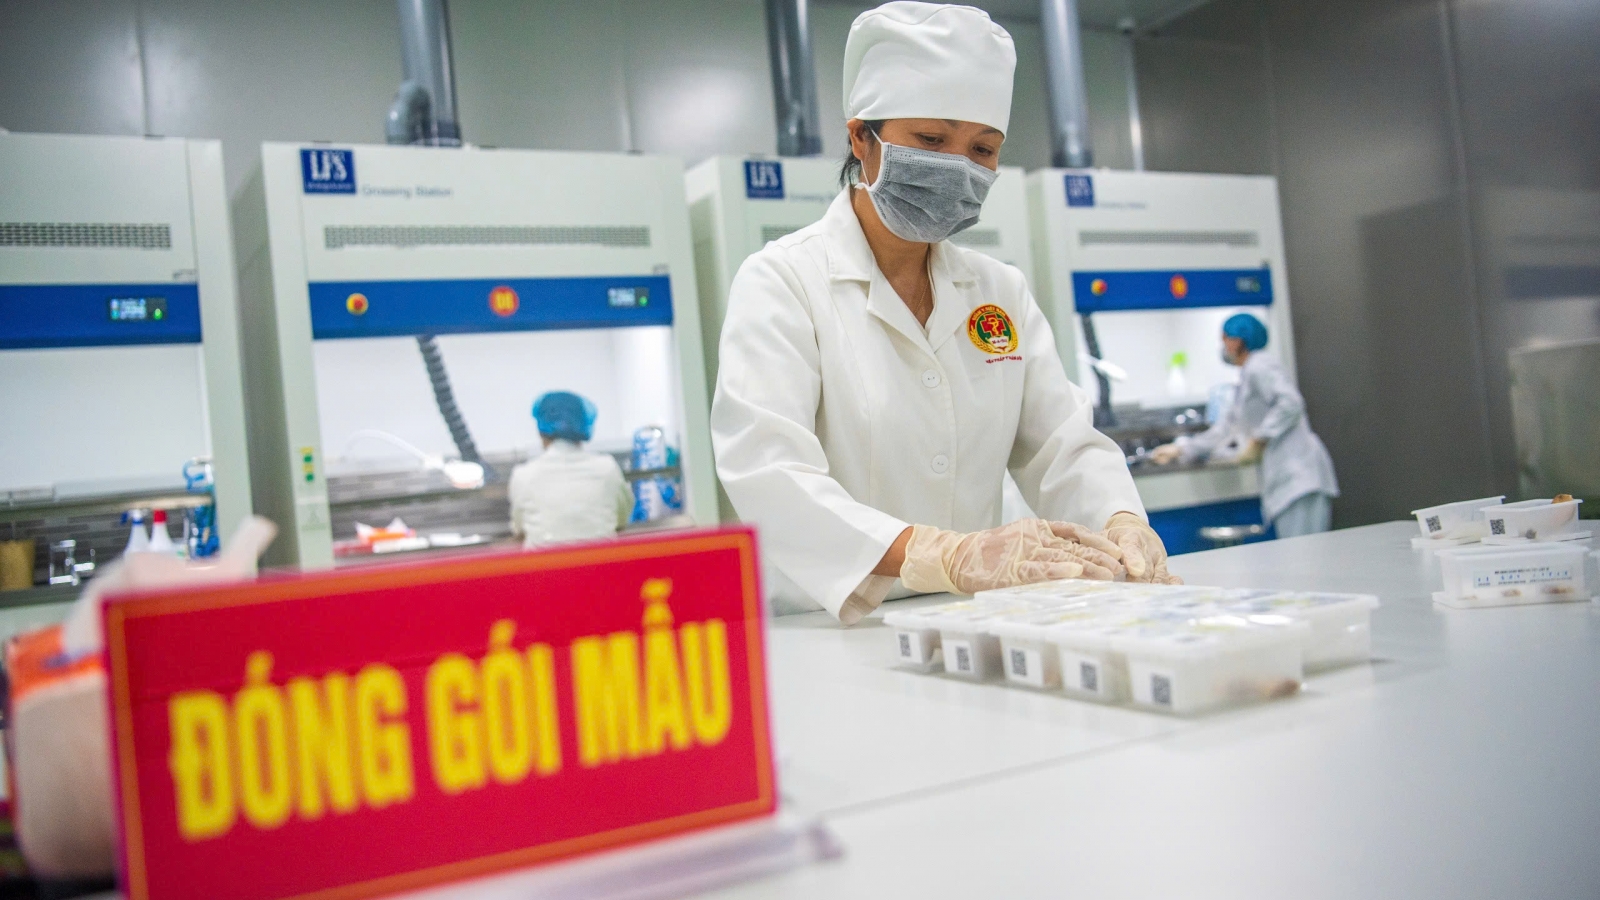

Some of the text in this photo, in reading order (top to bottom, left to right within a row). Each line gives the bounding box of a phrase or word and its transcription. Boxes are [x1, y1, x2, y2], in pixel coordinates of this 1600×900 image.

[414, 183, 452, 196] Station
[168, 578, 732, 842] ĐÓNG GÓI MẪU
